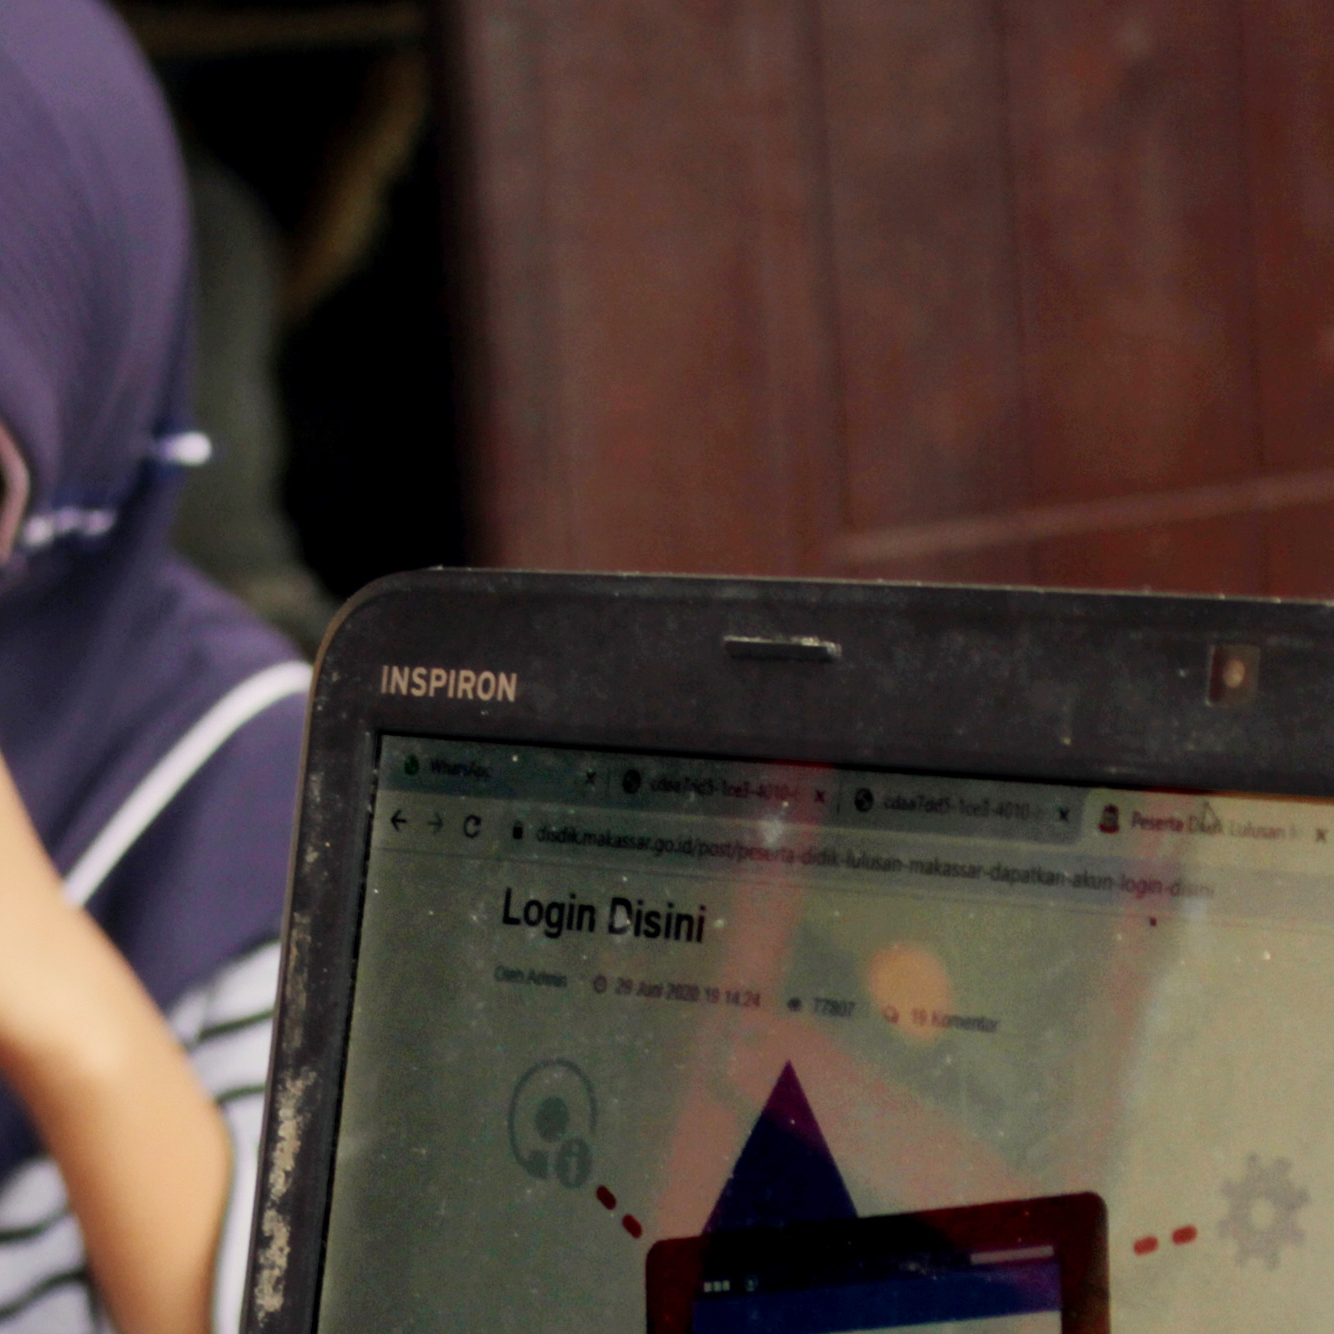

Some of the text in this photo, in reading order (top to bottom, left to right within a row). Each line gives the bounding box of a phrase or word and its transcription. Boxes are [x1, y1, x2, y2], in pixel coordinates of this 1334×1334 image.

[380, 664, 518, 702] INSPIRON
[501, 886, 708, 945] Login Disini
